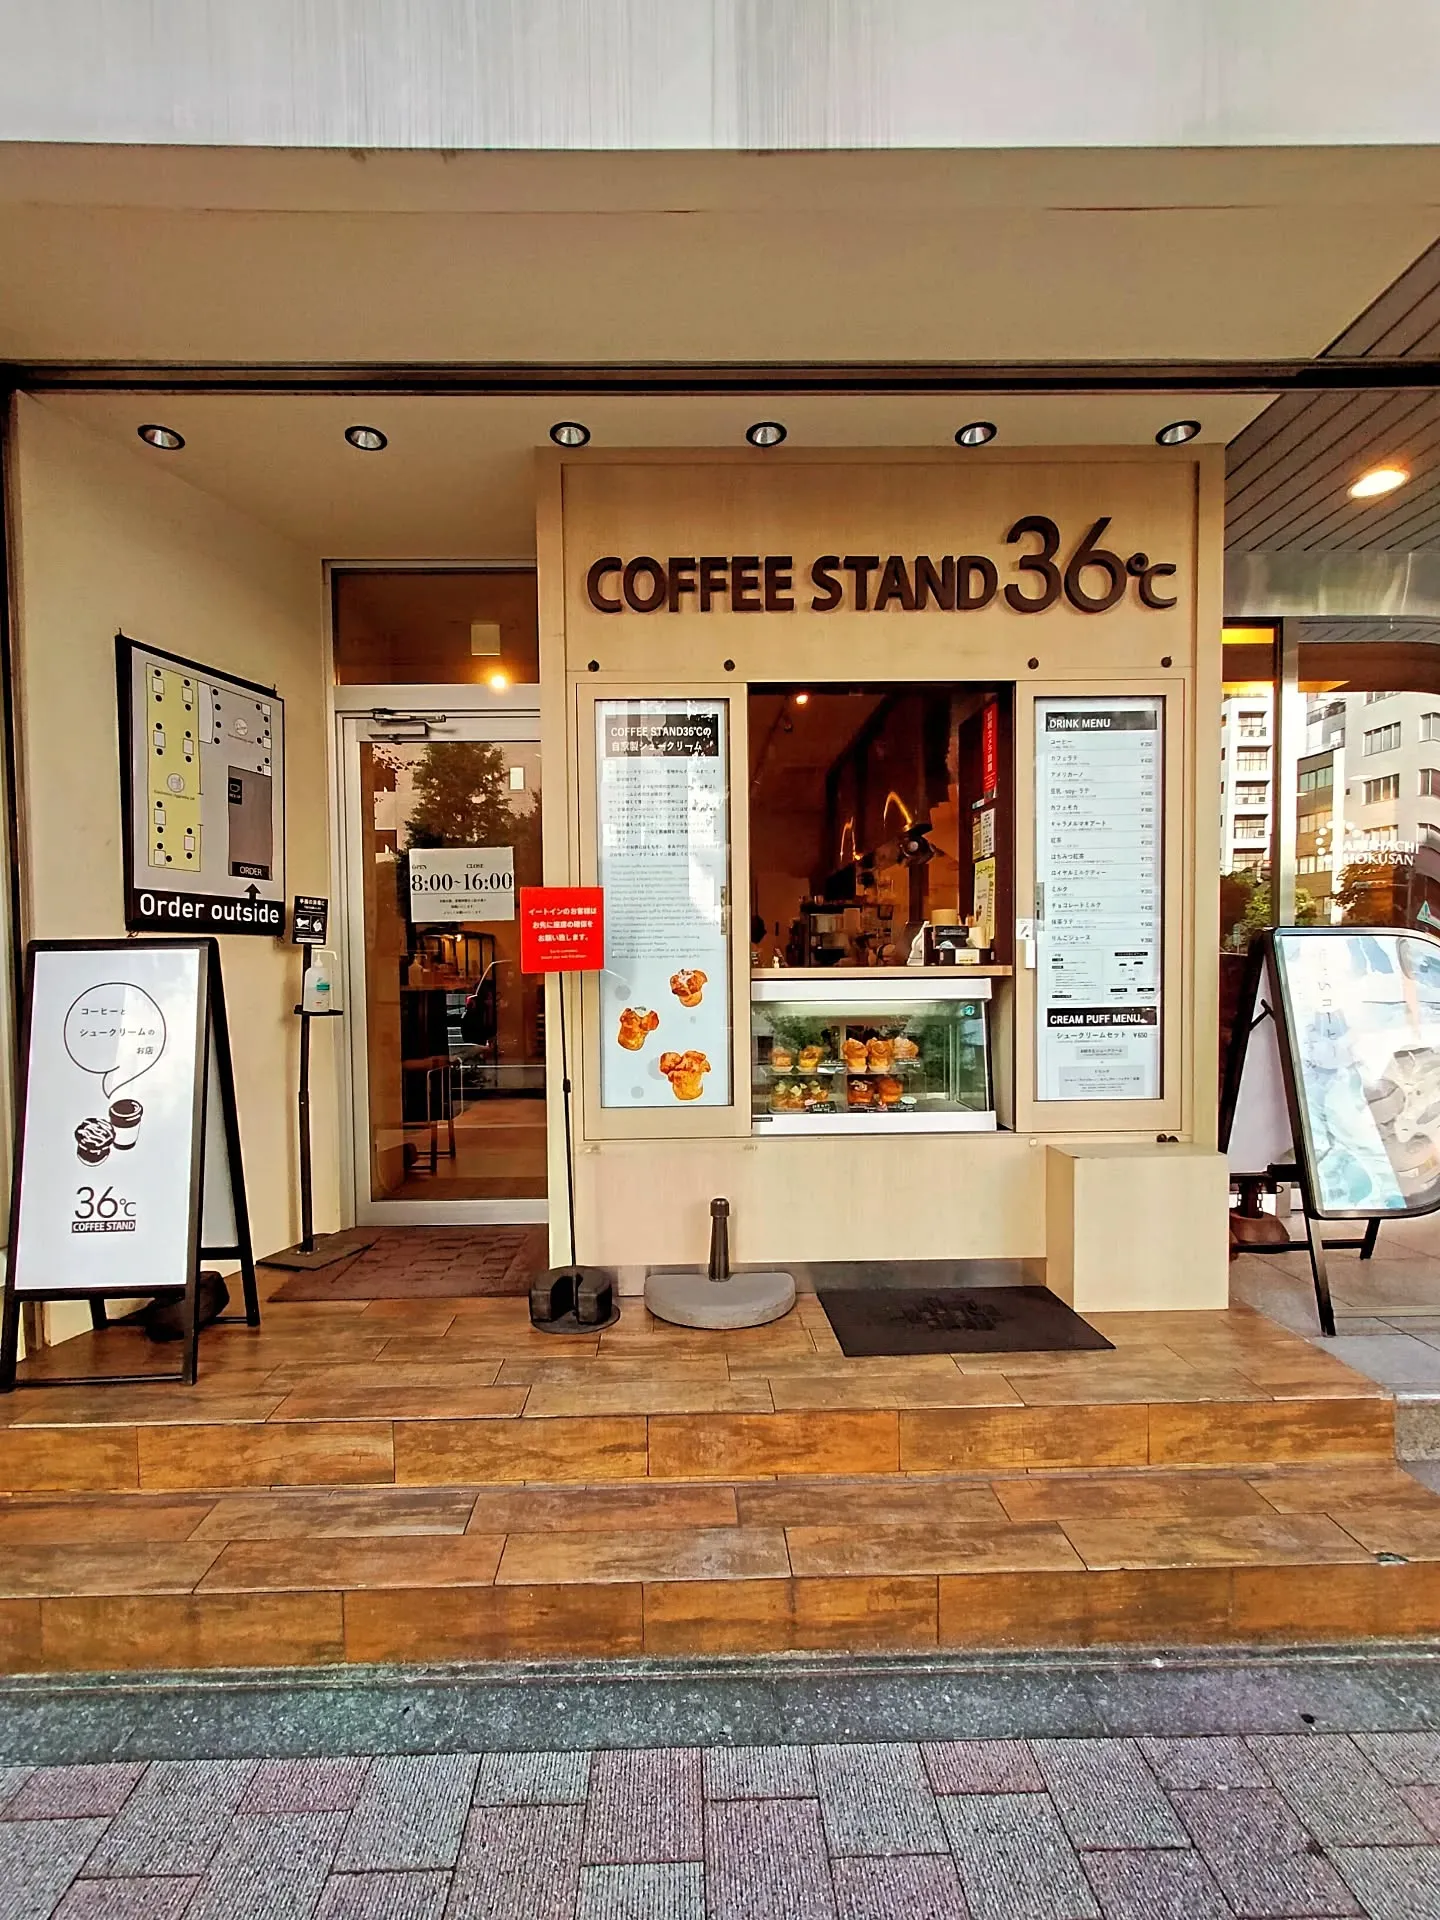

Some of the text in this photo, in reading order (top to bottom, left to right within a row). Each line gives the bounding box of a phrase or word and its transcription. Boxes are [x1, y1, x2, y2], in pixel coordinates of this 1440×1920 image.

[587, 555, 795, 613] COFFEE
[810, 555, 999, 612] STAND
[1049, 718, 1111, 728] DRINK MENU
[611, 727, 648, 736] COFFEE
[611, 741, 702, 752] 自家製シュークリーム
[239, 866, 263, 877] ORDER
[140, 893, 279, 923] Order outside
[528, 907, 597, 916] イートインのお客様は
[537, 933, 588, 942] お願い致します。
[81, 1007, 126, 1015] コーヒーと
[1050, 1014, 1140, 1025] CREAM PUFF MENU
[80, 1028, 155, 1037] シュークリームの
[136, 1046, 154, 1055] お店
[73, 1221, 135, 1232] COFFEE STAND
